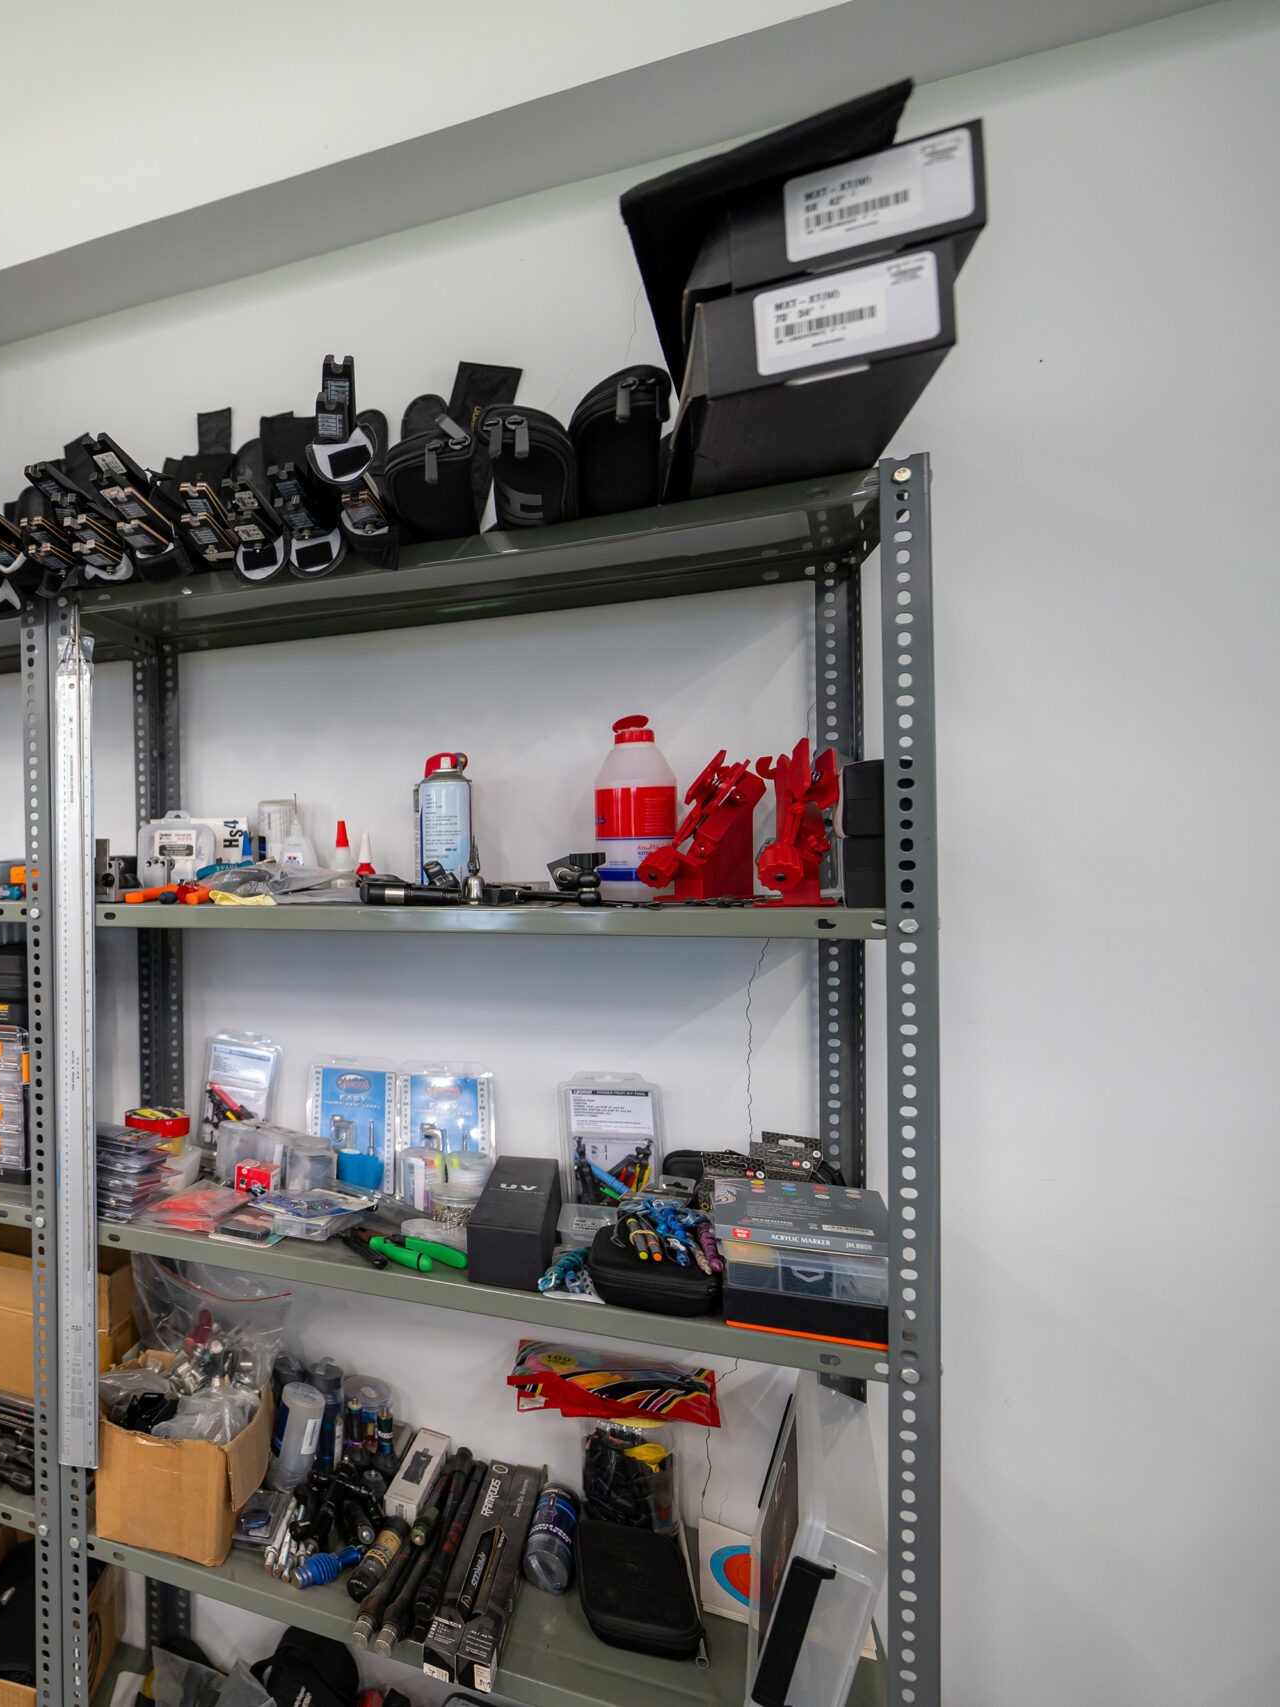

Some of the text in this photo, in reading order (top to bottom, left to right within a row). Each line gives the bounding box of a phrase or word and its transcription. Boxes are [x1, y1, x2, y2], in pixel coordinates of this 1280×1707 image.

[770, 1234, 800, 1243] ACRYLIC
[800, 1237, 832, 1246] MARKER
[480, 1478, 502, 1518] RAMRODS
